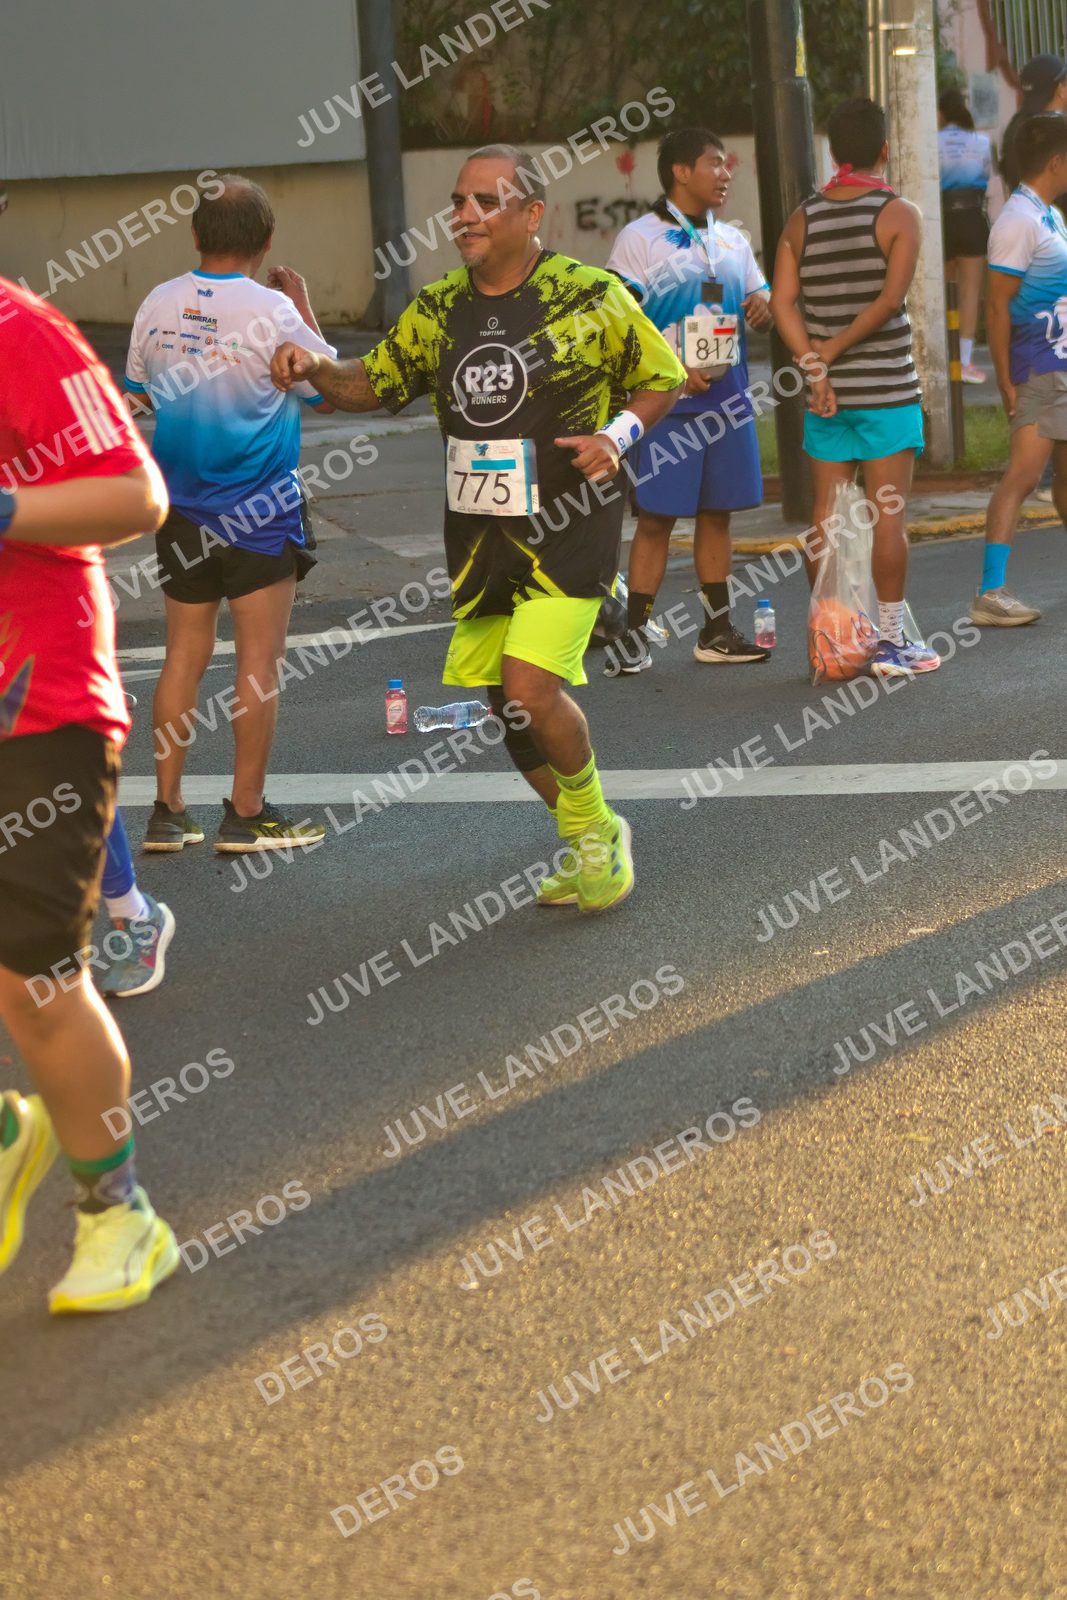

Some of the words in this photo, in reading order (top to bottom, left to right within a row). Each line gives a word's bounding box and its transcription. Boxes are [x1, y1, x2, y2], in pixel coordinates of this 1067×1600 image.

[695, 337, 734, 361] 812
[465, 364, 513, 393] R23
[471, 395, 507, 405] RUNNERS
[453, 470, 511, 505] 775
